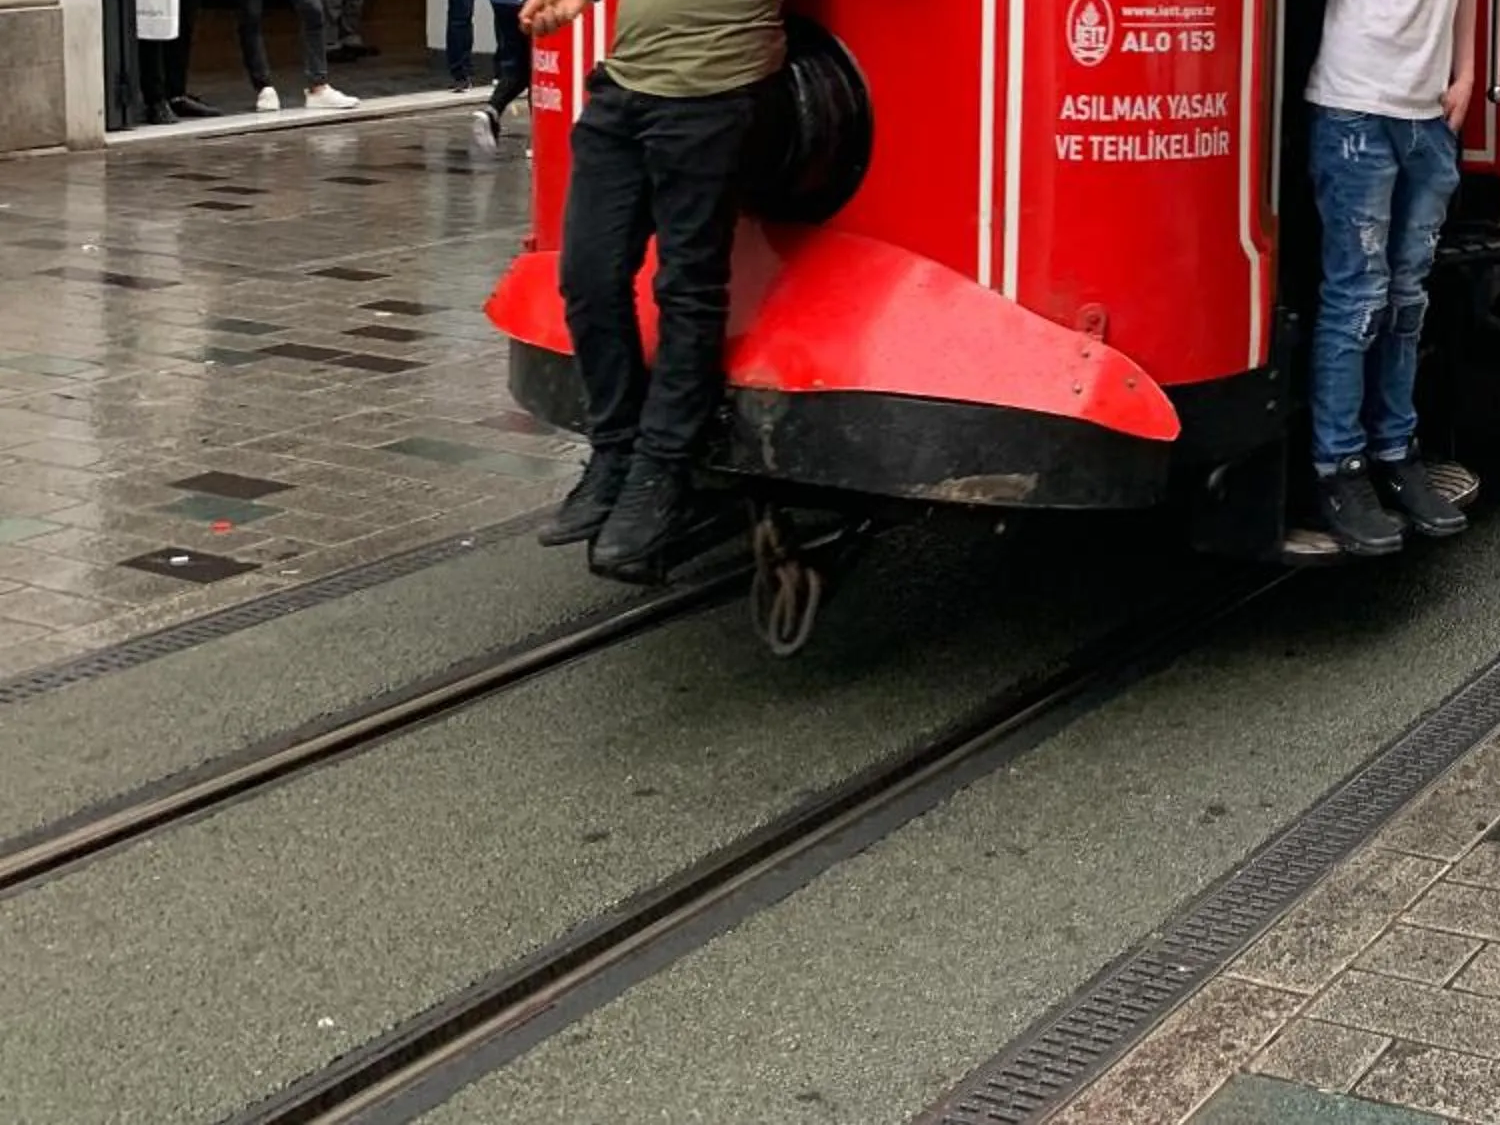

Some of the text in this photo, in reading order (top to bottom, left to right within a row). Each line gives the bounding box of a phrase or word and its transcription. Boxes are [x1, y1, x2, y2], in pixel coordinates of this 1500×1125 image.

[1120, 30, 1216, 53] ALO 153
[1060, 91, 1229, 121] ASILMAK YASAK
[1055, 125, 1230, 162] VE TEHLİKELİDİR
